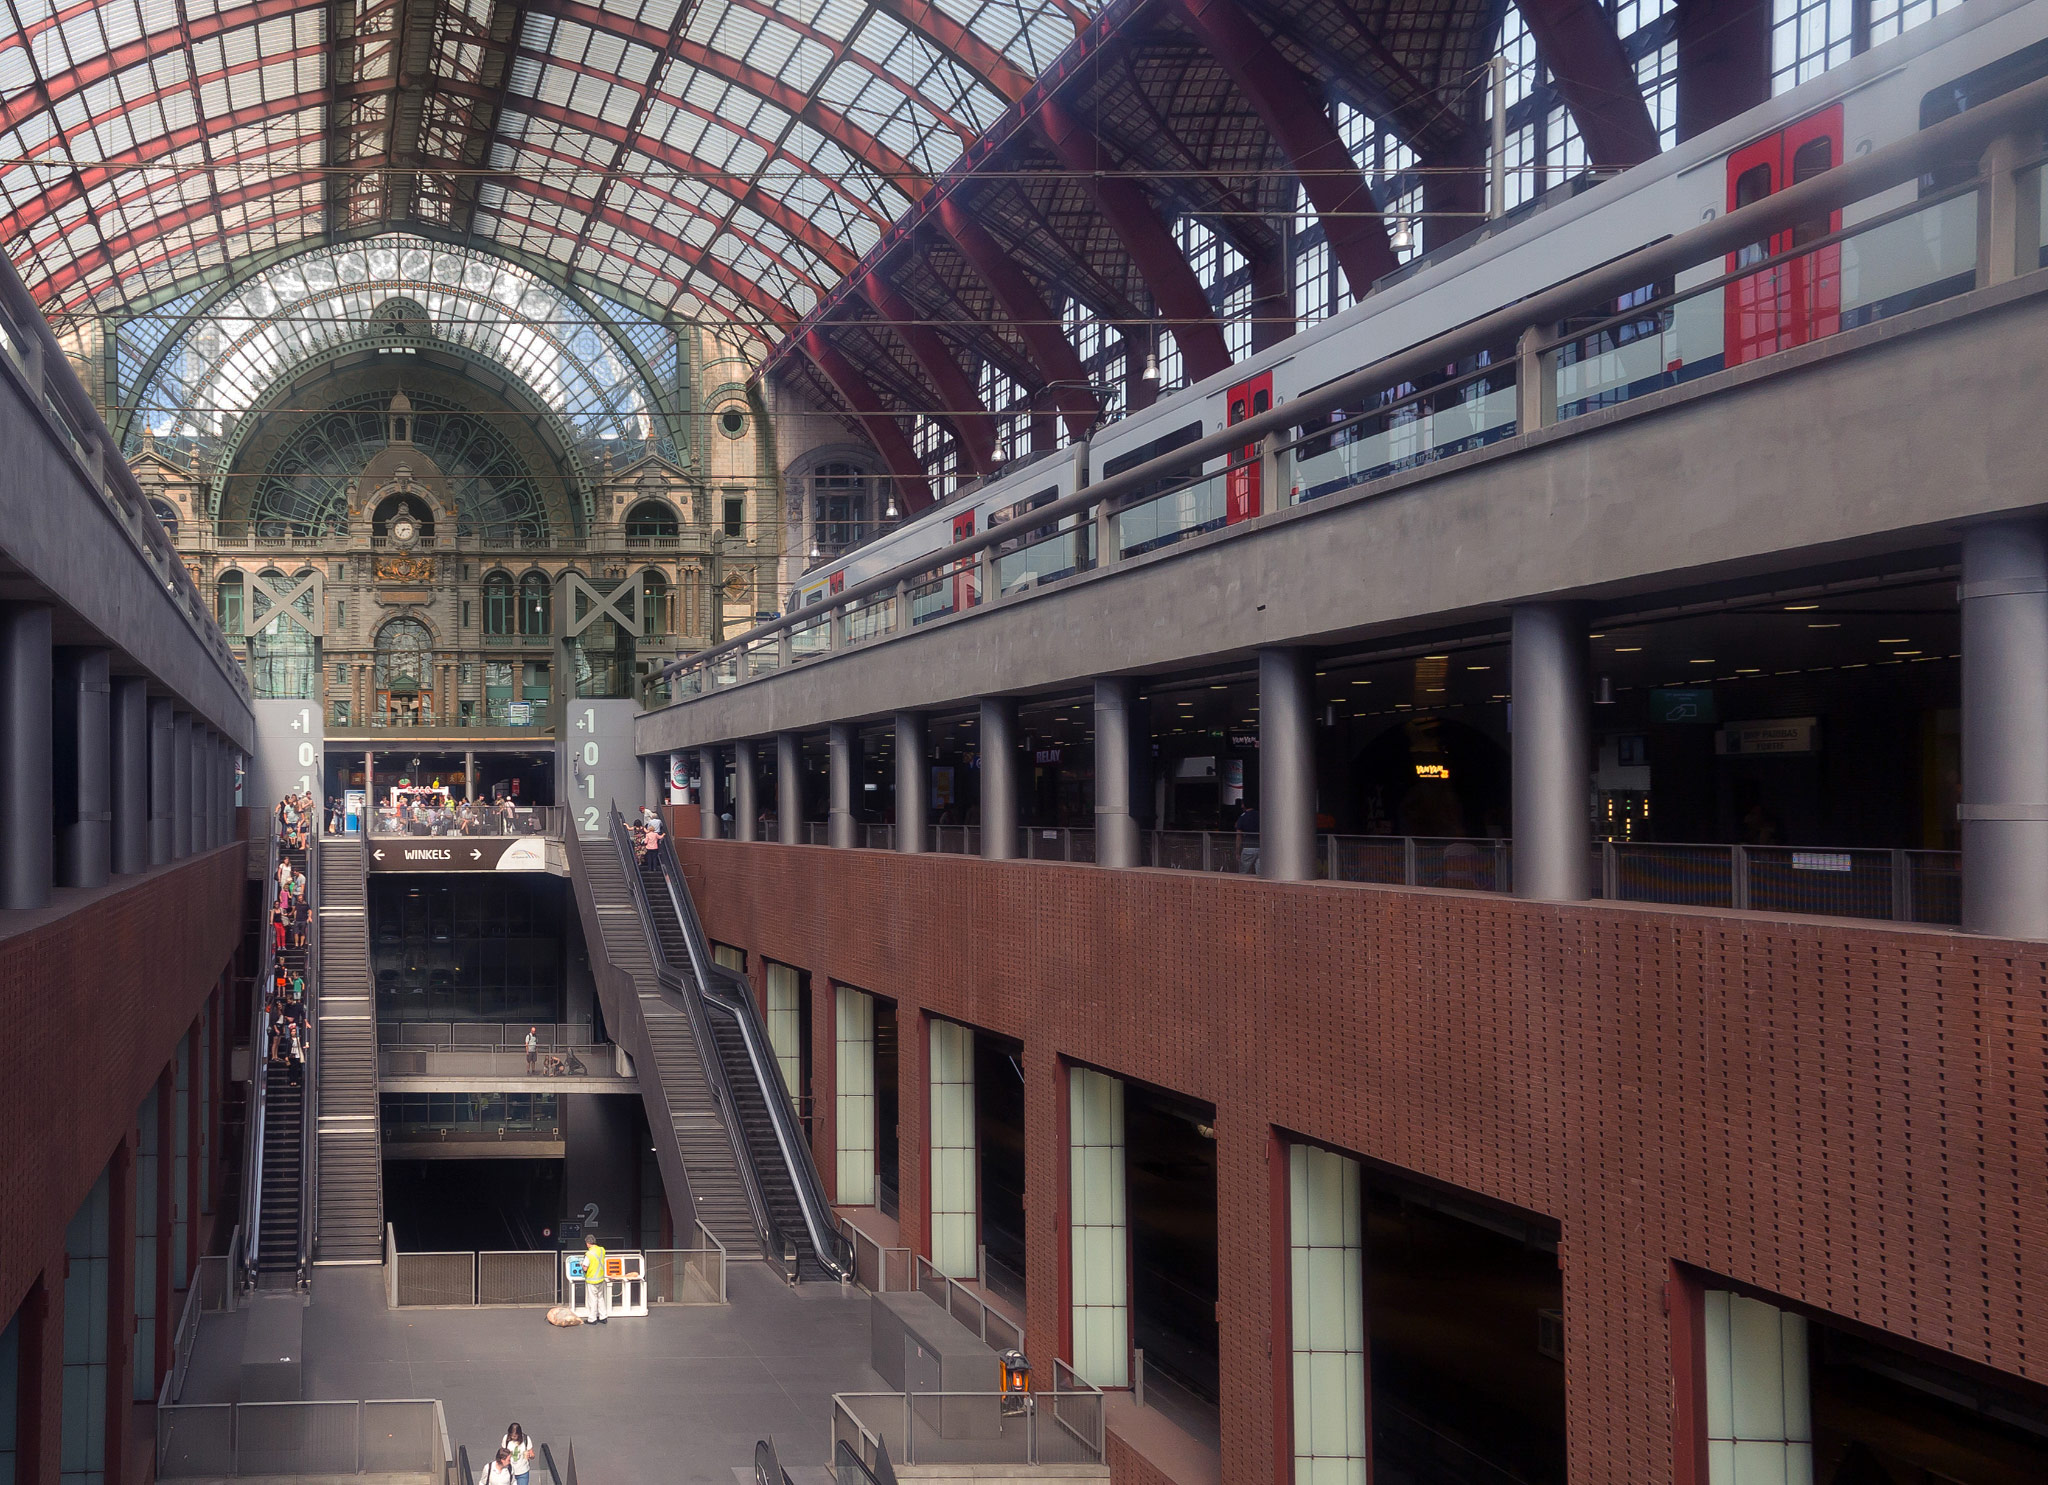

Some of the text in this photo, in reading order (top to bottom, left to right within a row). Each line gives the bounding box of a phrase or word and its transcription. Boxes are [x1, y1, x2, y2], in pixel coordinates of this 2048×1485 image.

[290, 708, 310, 734] +1
[576, 708, 595, 733] +1
[299, 742, 314, 767] 0
[584, 741, 599, 766] 0
[1036, 749, 1060, 763] RELAY
[579, 774, 595, 799] -1
[578, 806, 600, 831] -2
[404, 849, 451, 860] WINKELS
